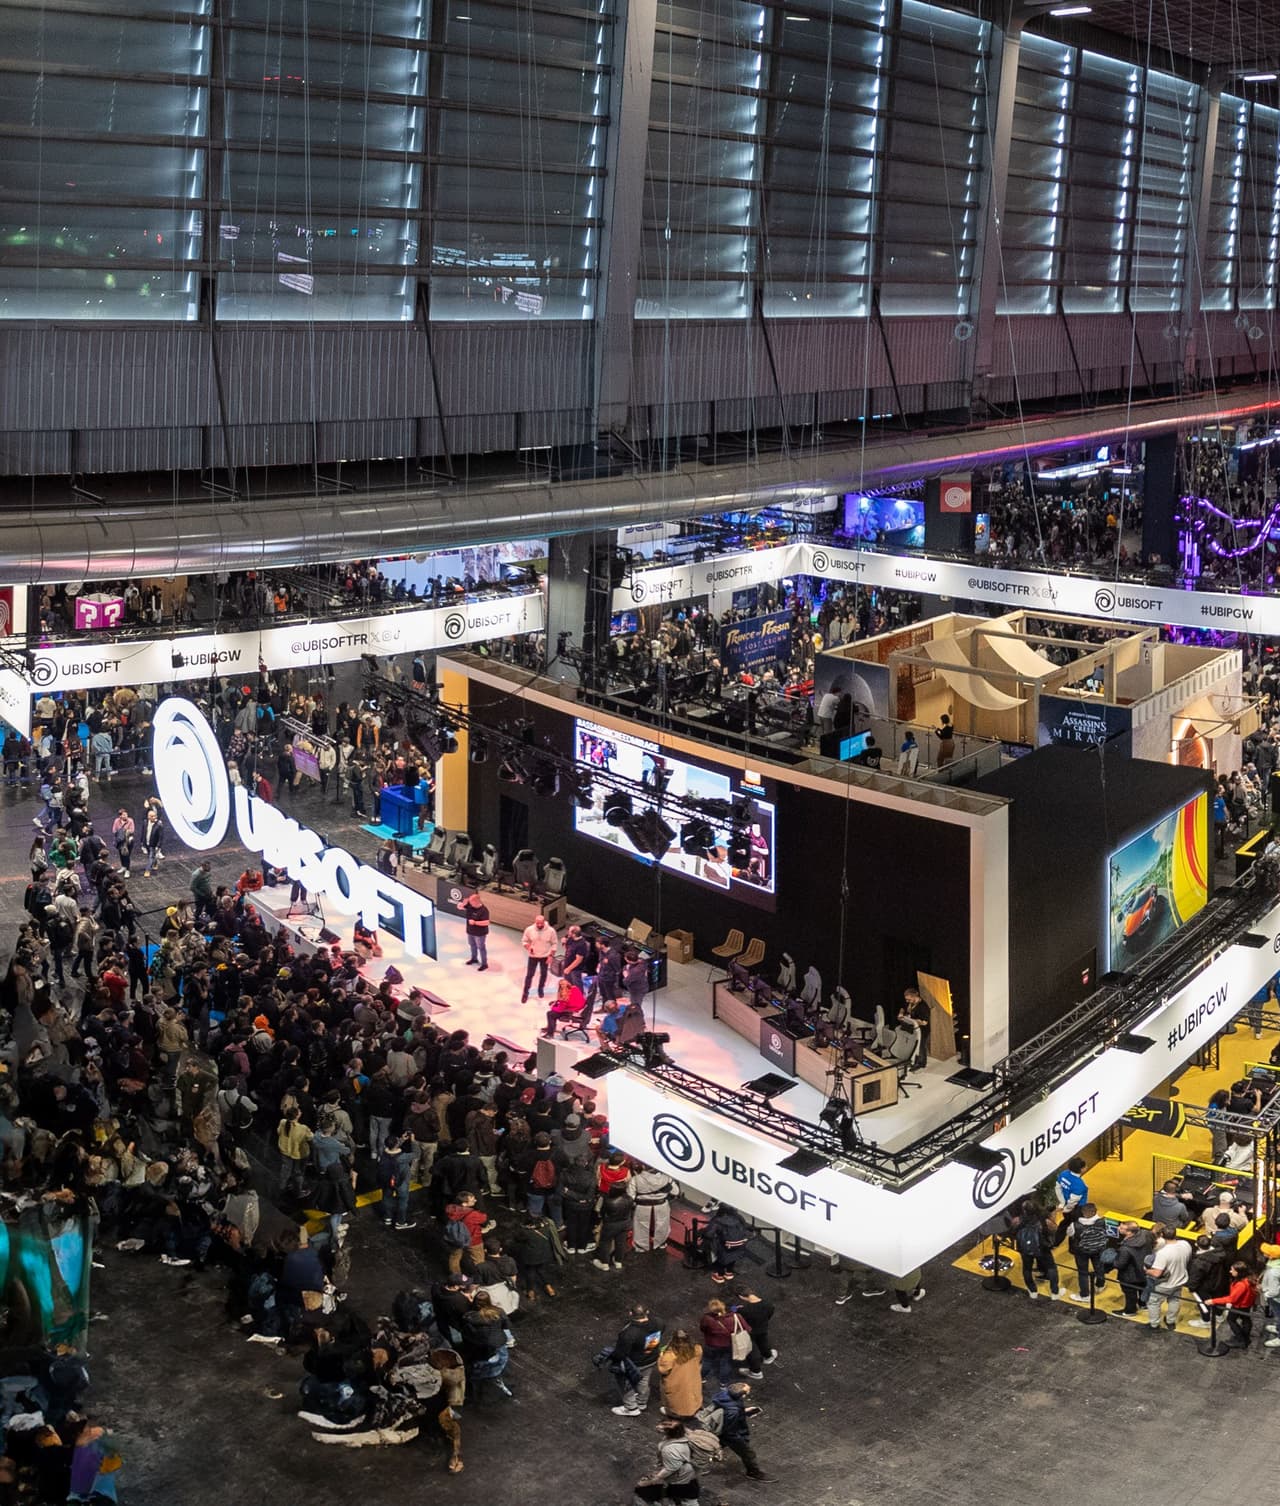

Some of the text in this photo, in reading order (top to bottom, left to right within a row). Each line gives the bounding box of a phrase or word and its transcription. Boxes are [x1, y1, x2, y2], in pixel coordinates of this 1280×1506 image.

[706, 565, 753, 583] @UBISOFTFR
[830, 558, 866, 572] UBISOFT
[895, 568, 937, 582] #UBIPGW
[649, 579, 683, 594] UBISOFT
[968, 577, 1030, 596] @UBISOFTFR
[1118, 597, 1164, 611] UBISOFT
[1201, 605, 1254, 621] #UBIPGW
[467, 613, 513, 631] UBISOFT
[291, 634, 369, 654] @UBISOFTFR
[61, 660, 121, 677] UBISOFT
[1053, 728, 1107, 744] MIRAG
[234, 784, 437, 961] UBISOFT
[1167, 982, 1229, 1051] #UBIPGW
[1020, 1090, 1100, 1167] UBISOFT
[711, 1149, 839, 1221] UBISOFT
